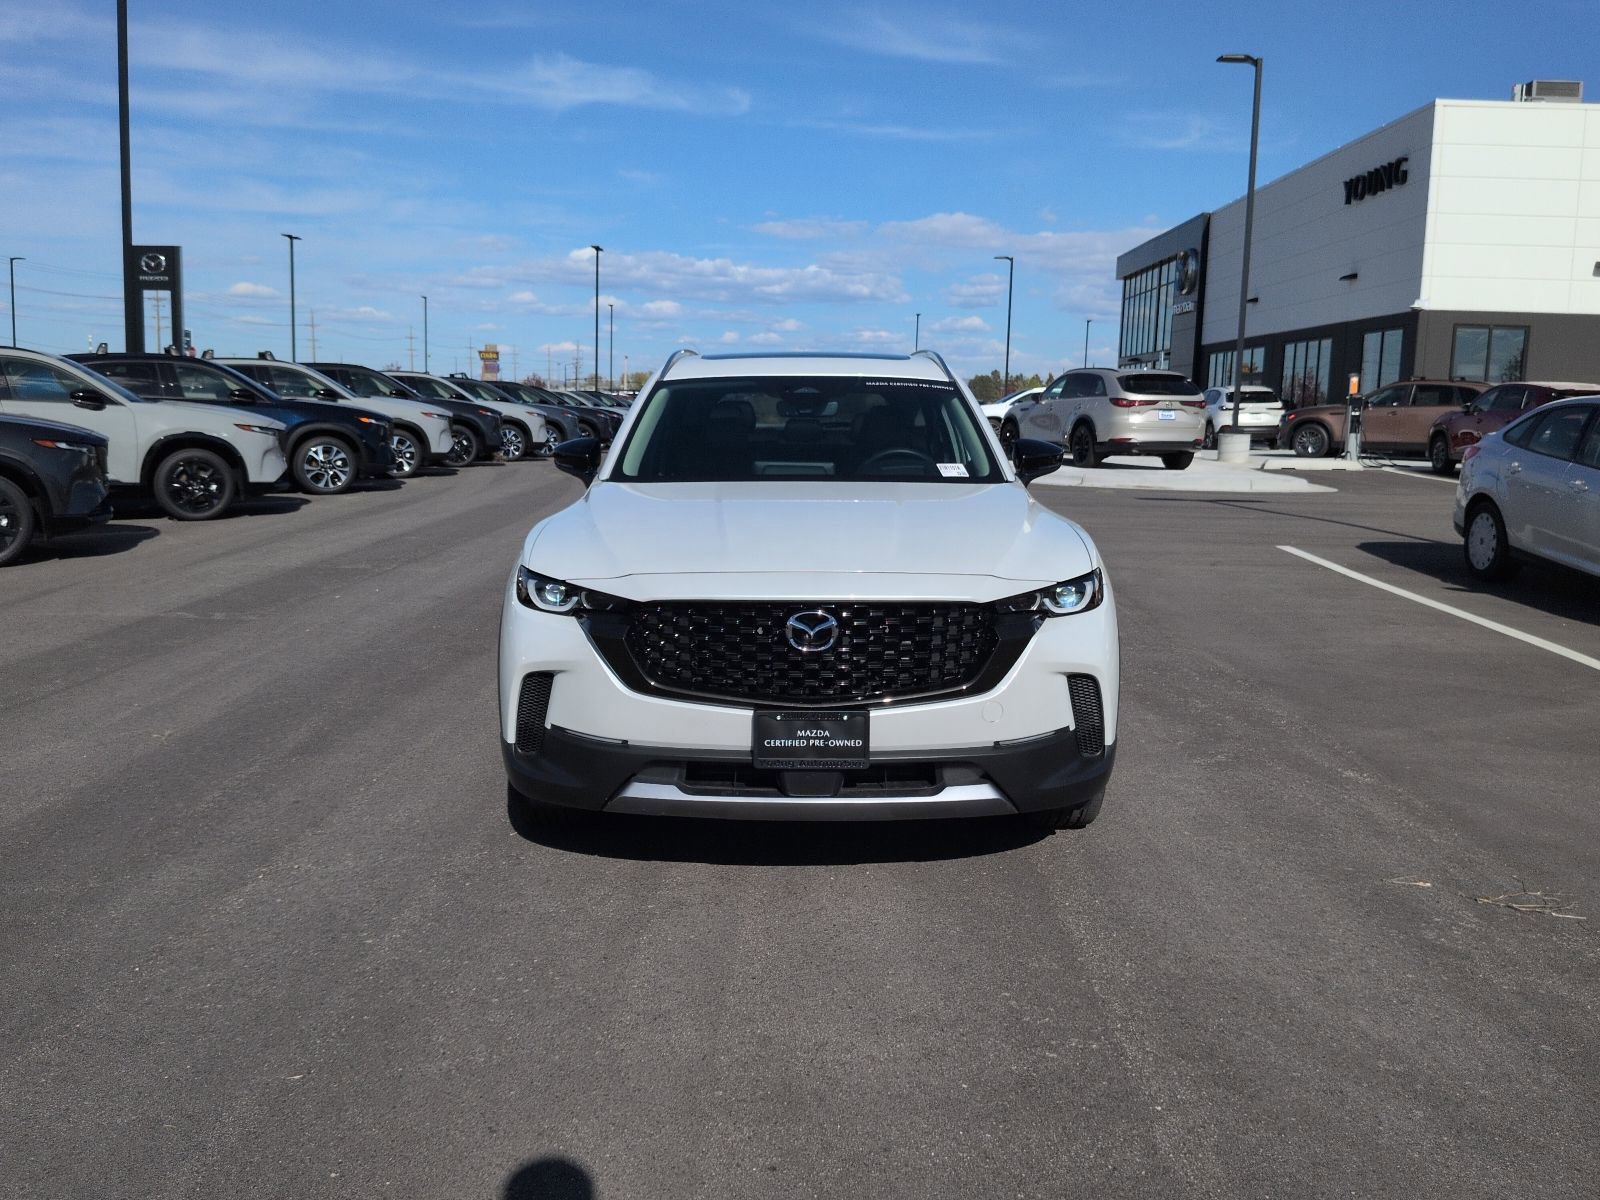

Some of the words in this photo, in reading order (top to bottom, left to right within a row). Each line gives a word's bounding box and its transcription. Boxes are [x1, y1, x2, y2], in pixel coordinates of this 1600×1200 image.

[1343, 157, 1408, 205] YOUNG
[764, 739, 807, 747] CERTIFIED
[809, 739, 863, 747] PRE-OWNED
